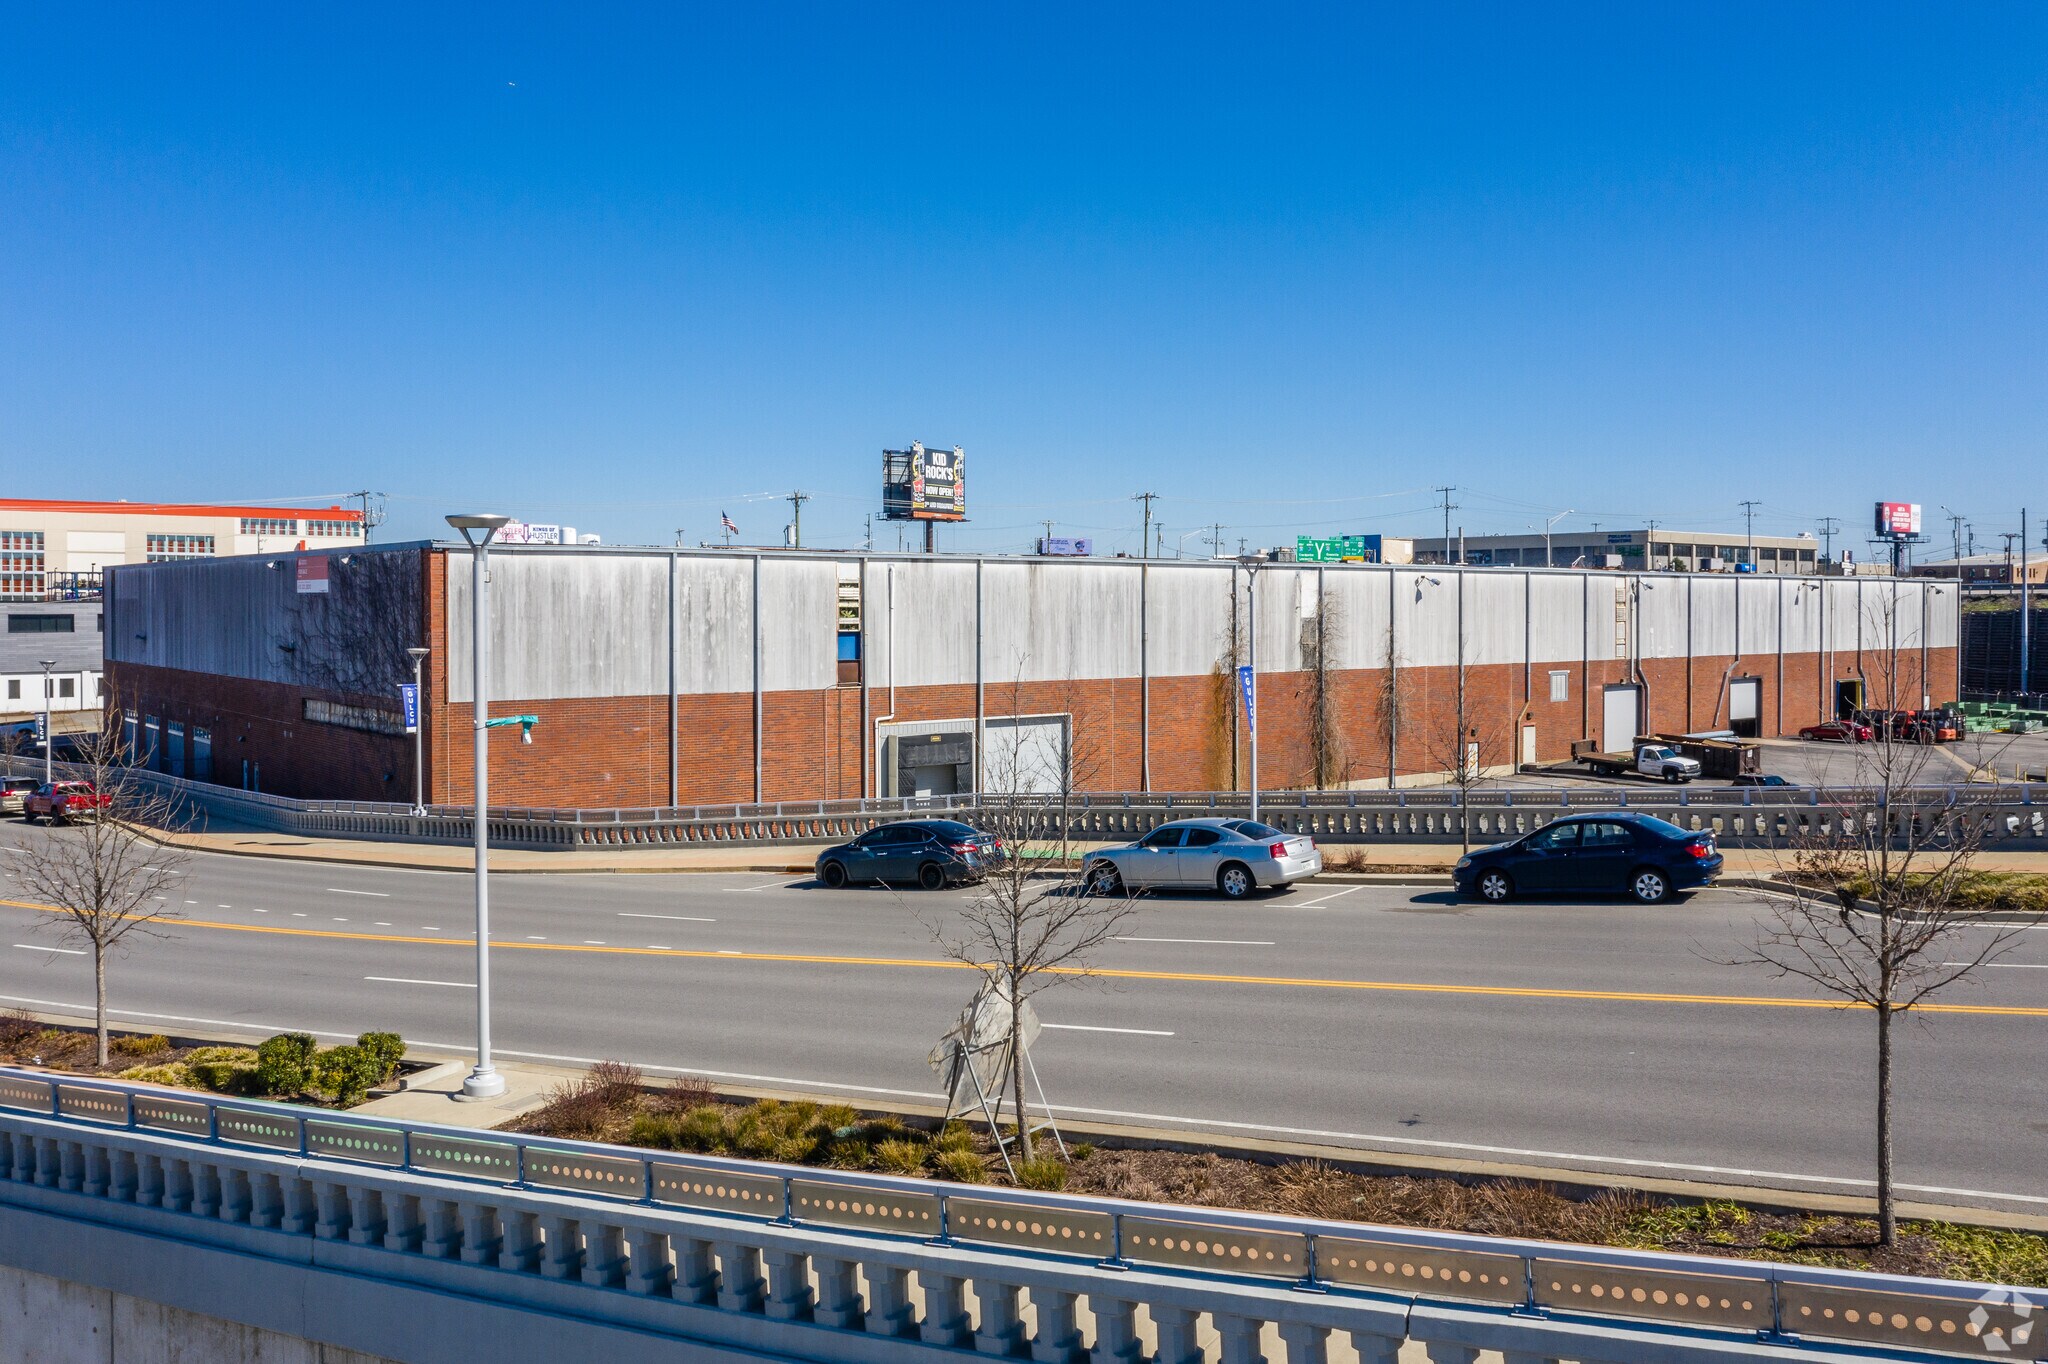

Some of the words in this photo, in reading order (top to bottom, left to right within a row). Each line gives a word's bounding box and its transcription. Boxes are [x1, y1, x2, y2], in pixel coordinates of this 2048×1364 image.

[932, 452, 947, 466] KID
[925, 466, 953, 481] ROCK'S
[925, 485, 939, 496] NOW
[939, 486, 954, 497] OPEN!
[530, 532, 558, 540] HUSTLER
